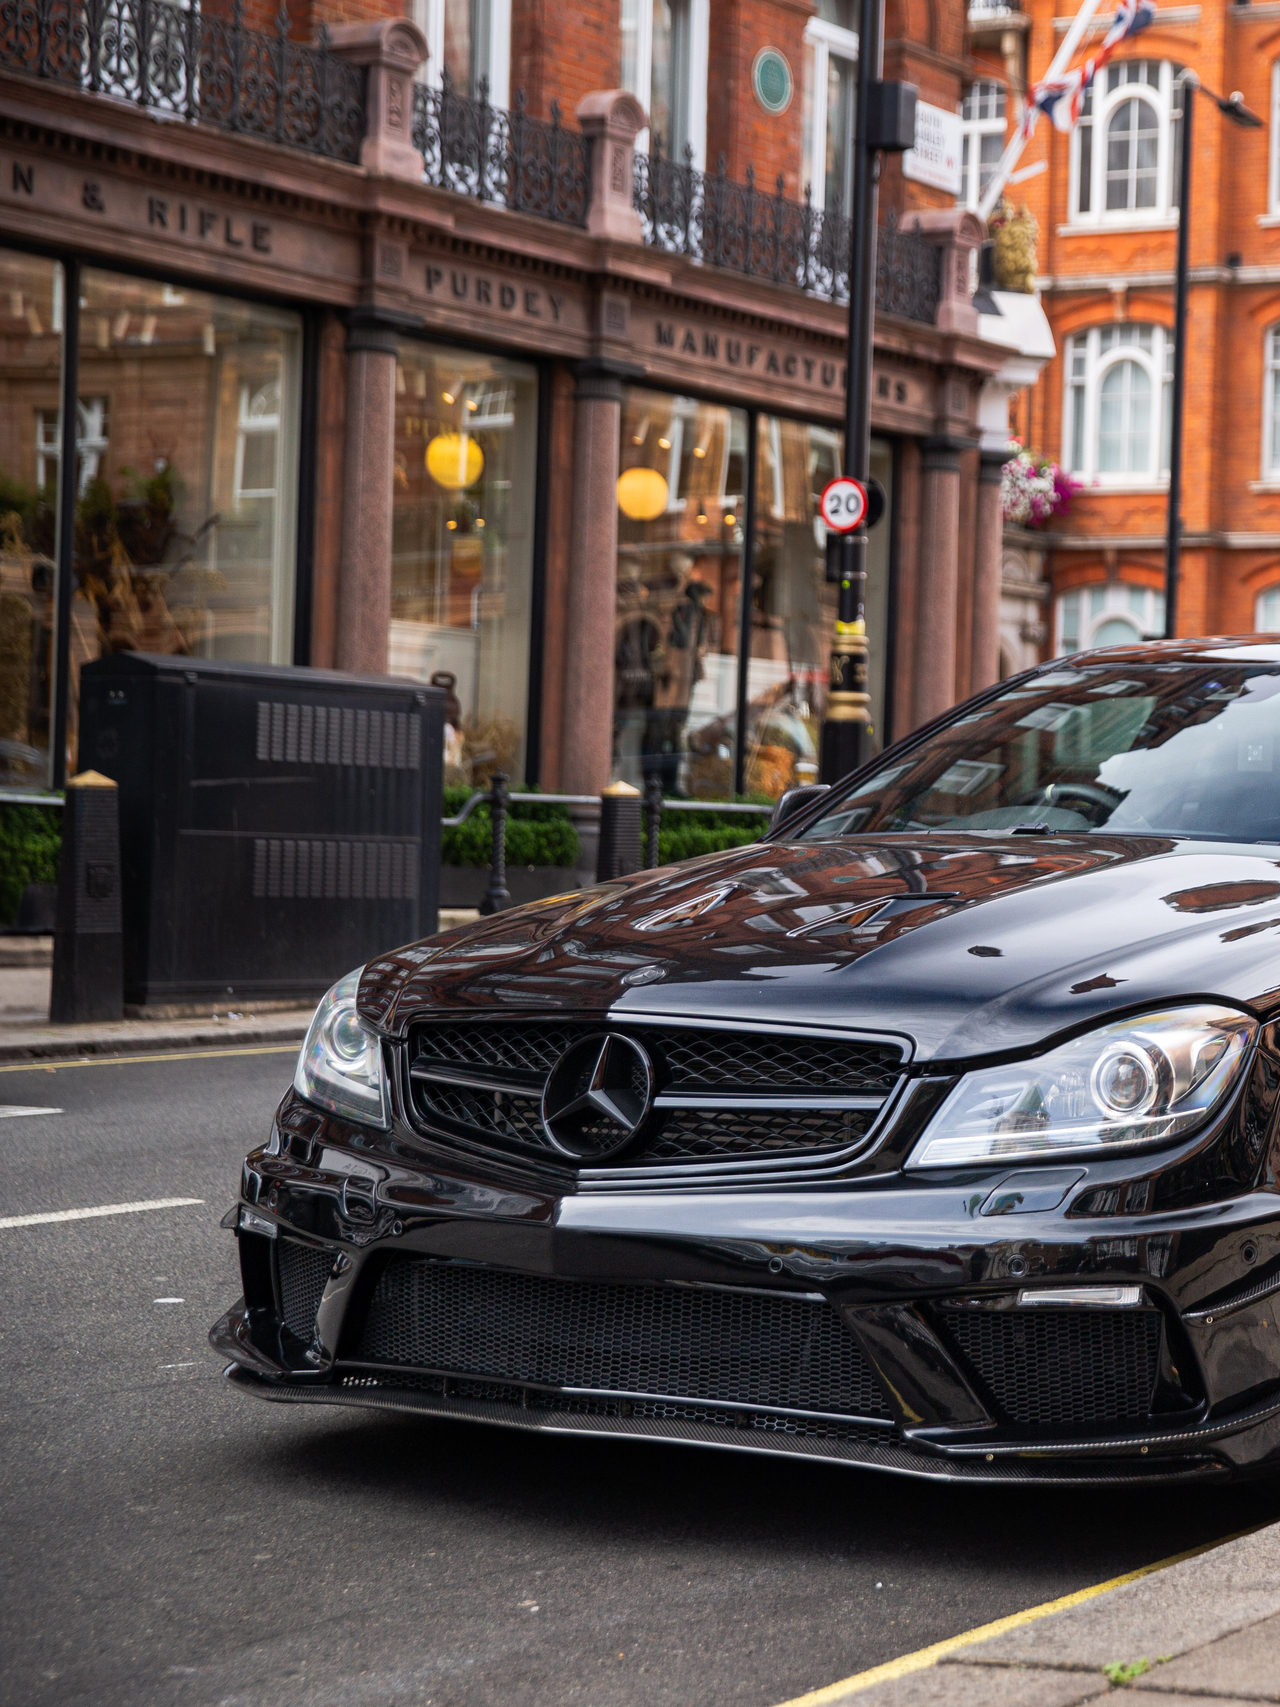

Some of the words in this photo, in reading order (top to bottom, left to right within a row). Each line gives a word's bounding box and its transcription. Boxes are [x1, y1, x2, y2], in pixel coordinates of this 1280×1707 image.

[83, 180, 106, 214] &
[149, 197, 273, 255] RIFLE
[425, 264, 563, 322] PURDEY
[655, 321, 908, 404] MANUFACTURS
[829, 493, 860, 514] 20
